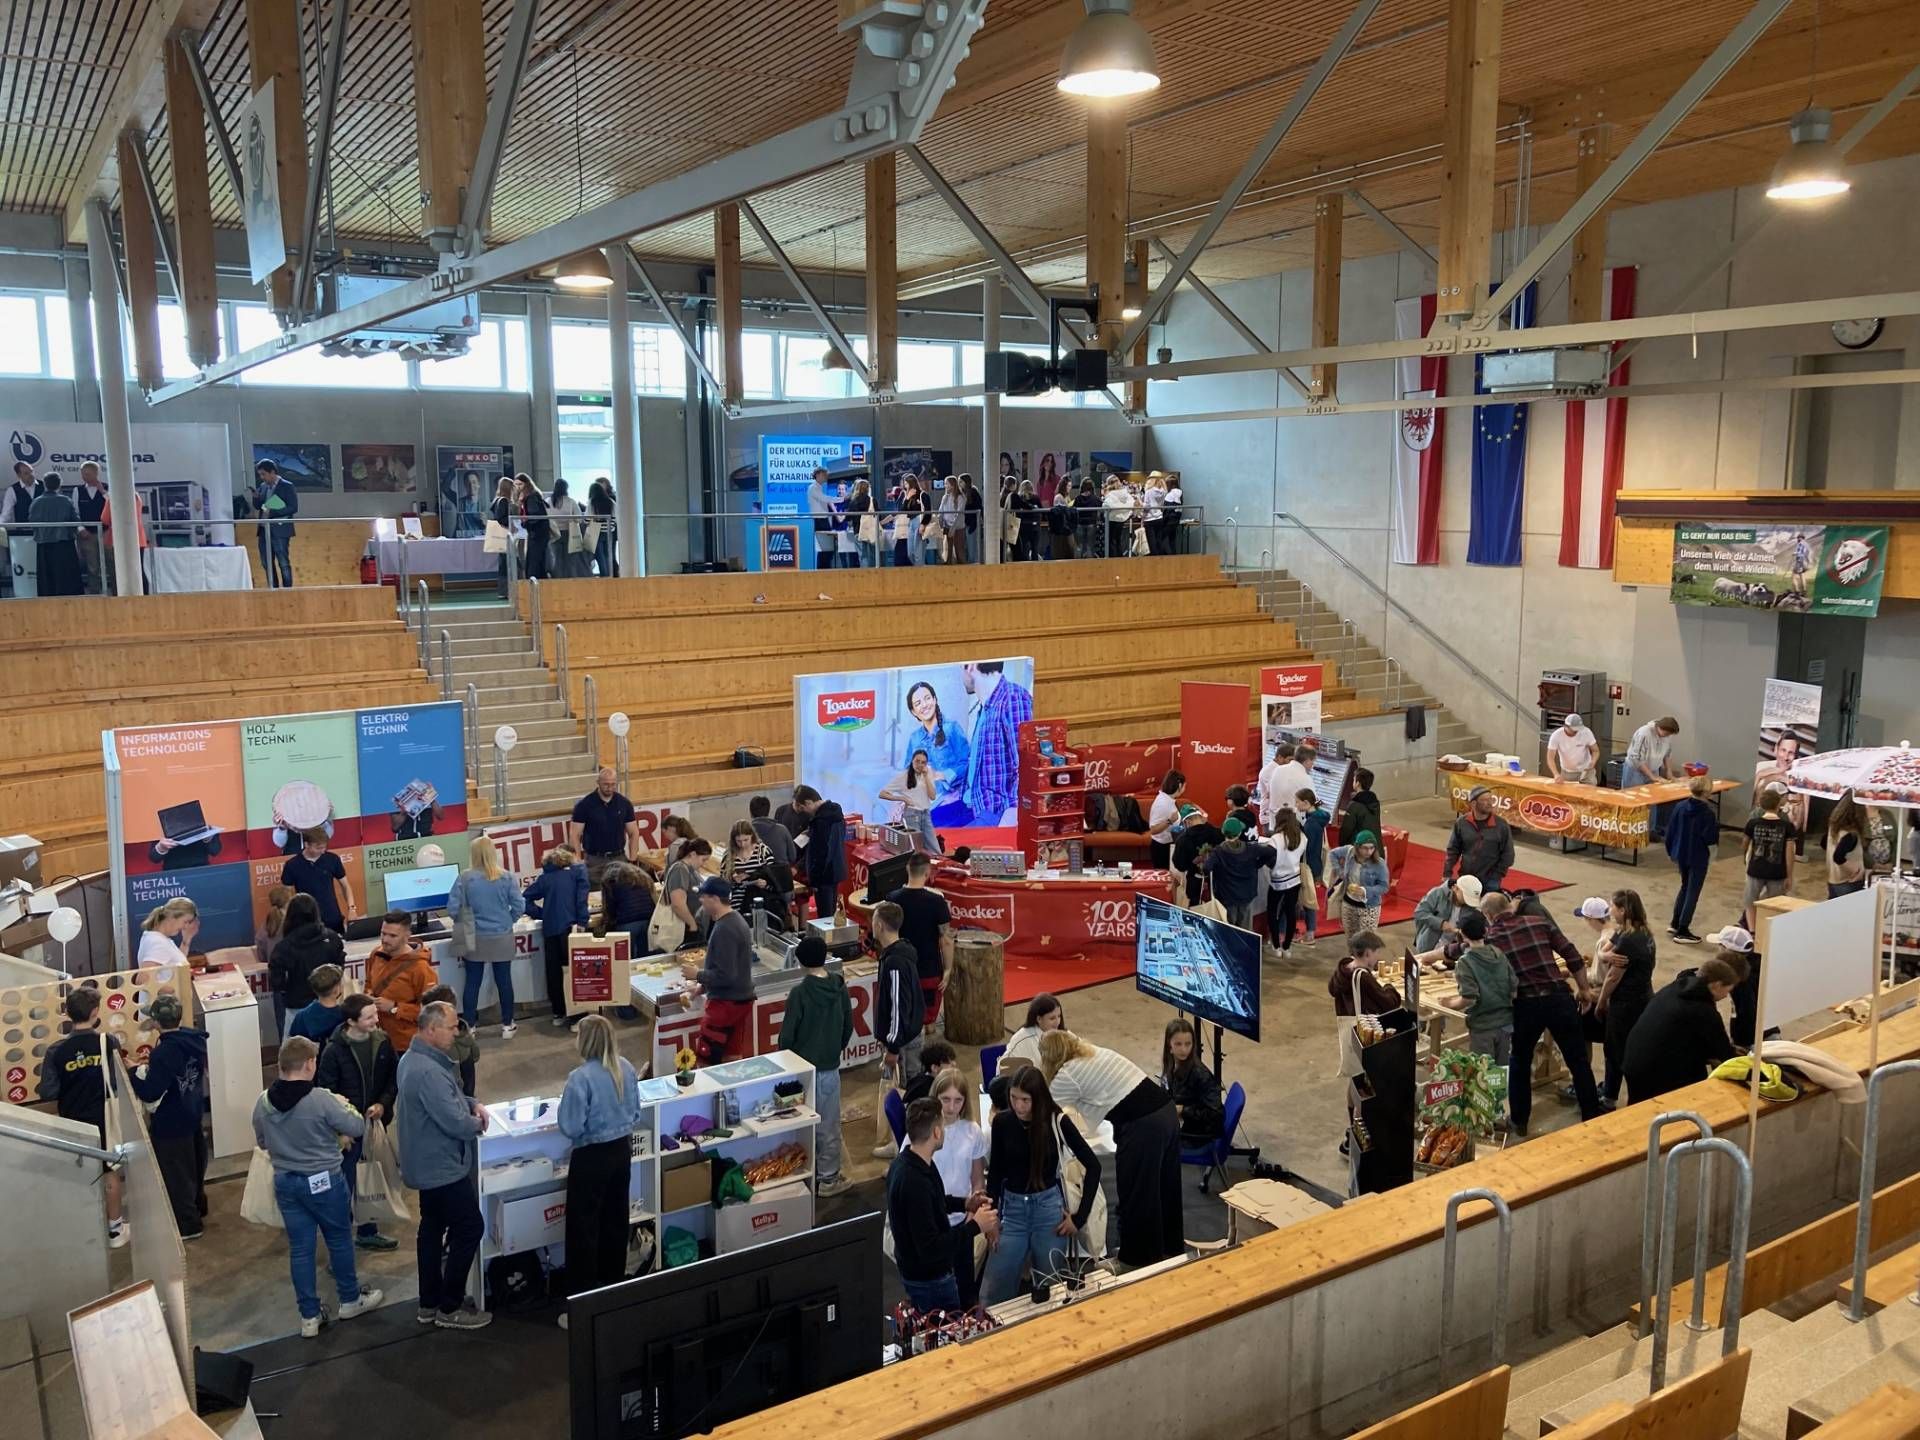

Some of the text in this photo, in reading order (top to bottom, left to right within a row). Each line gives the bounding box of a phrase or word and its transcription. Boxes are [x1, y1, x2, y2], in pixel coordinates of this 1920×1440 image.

[769, 447, 839, 456] DER RICHTIGE WEG
[769, 458, 819, 468] FÜR LUKAS &
[1680, 549, 1776, 563] Unserem Vieh die Almen,
[1695, 562, 1711, 571] dem
[1712, 562, 1730, 572] Wolf
[1731, 563, 1744, 572] die
[1277, 674, 1308, 686] Loacker
[823, 697, 871, 715] Loacker
[361, 712, 409, 726] ELEKTRO
[246, 723, 276, 735] HOLZ
[362, 723, 408, 736] TECHNIK
[121, 728, 212, 745] INFORMATIONS
[247, 734, 296, 747] TECHNIK
[122, 741, 207, 757] TECHNOLOGIE
[1190, 740, 1236, 754] Loacker
[1524, 800, 1570, 822] JOAST
[368, 845, 415, 858] PROZESS
[368, 856, 415, 869] TECHNIK
[132, 876, 180, 890] METALL
[132, 886, 187, 902] TECHNIK
[950, 902, 1006, 920] oacker
[1090, 900, 1133, 923] 100
[1086, 922, 1136, 937] YEARS
[842, 1041, 882, 1060] IMBER
[65, 1054, 103, 1073] GUST
[1430, 1082, 1460, 1100] Kelly's
[754, 1213, 776, 1227] Kelly's
